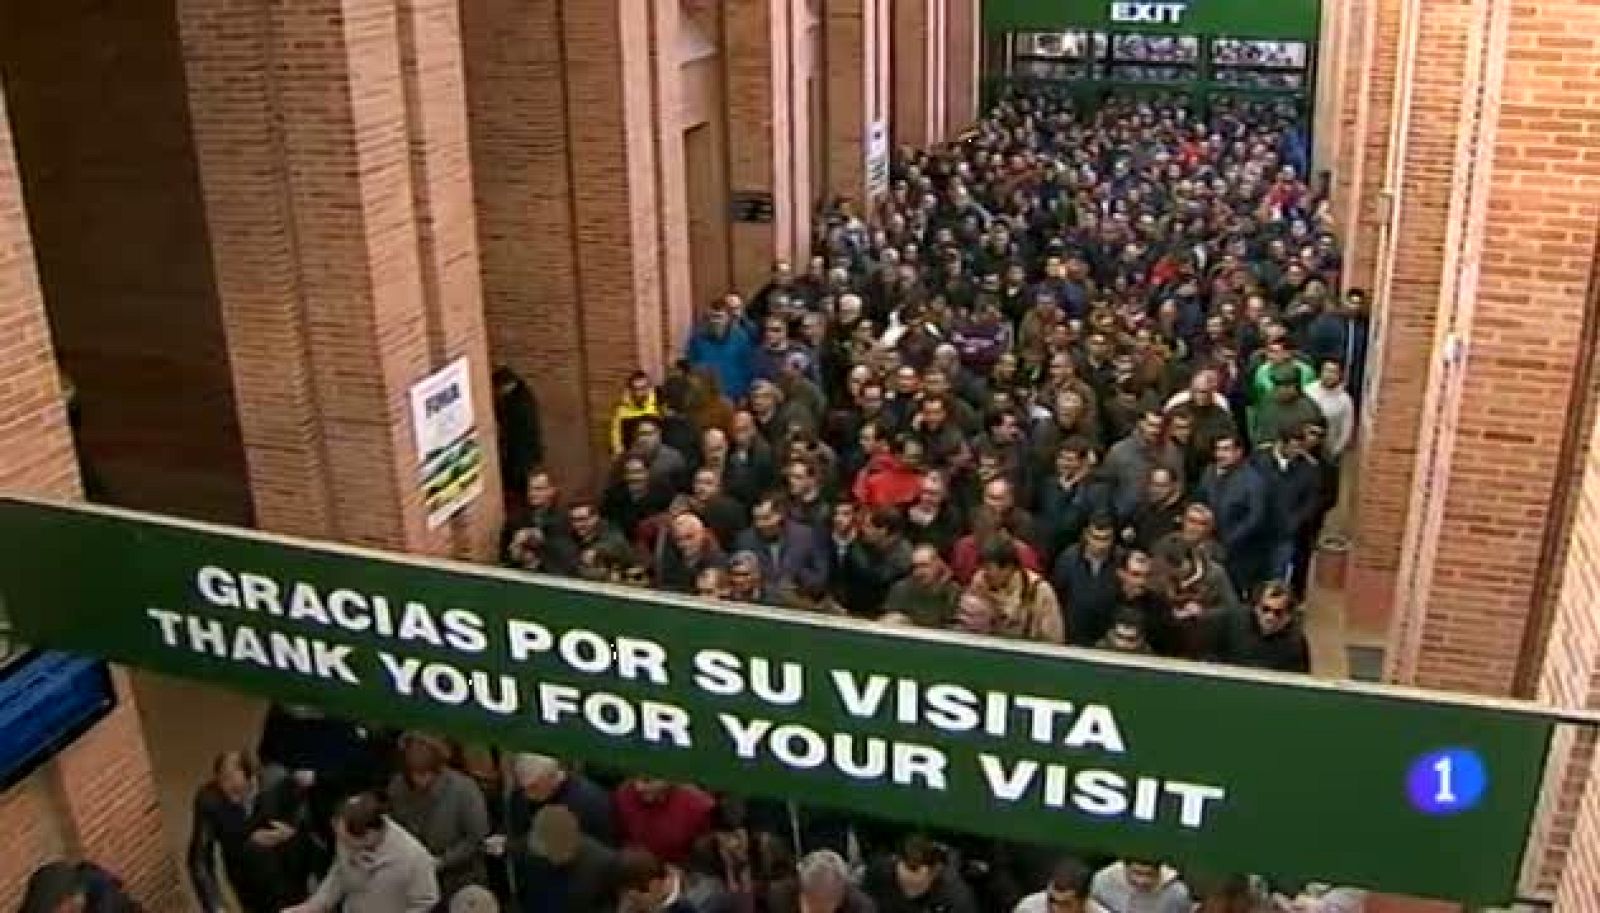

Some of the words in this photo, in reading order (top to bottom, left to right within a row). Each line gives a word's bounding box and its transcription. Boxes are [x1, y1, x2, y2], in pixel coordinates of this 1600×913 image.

[1110, 1, 1187, 24] EXIT
[148, 608, 359, 683] THANK
[379, 653, 519, 714] YOU
[539, 682, 692, 747] FOR
[719, 713, 948, 790] YOUR
[978, 753, 1225, 828] VISIT
[197, 567, 488, 652] GRACIAS
[508, 620, 669, 685] POR
[694, 649, 804, 704] SU
[831, 669, 1125, 752] VISITA
